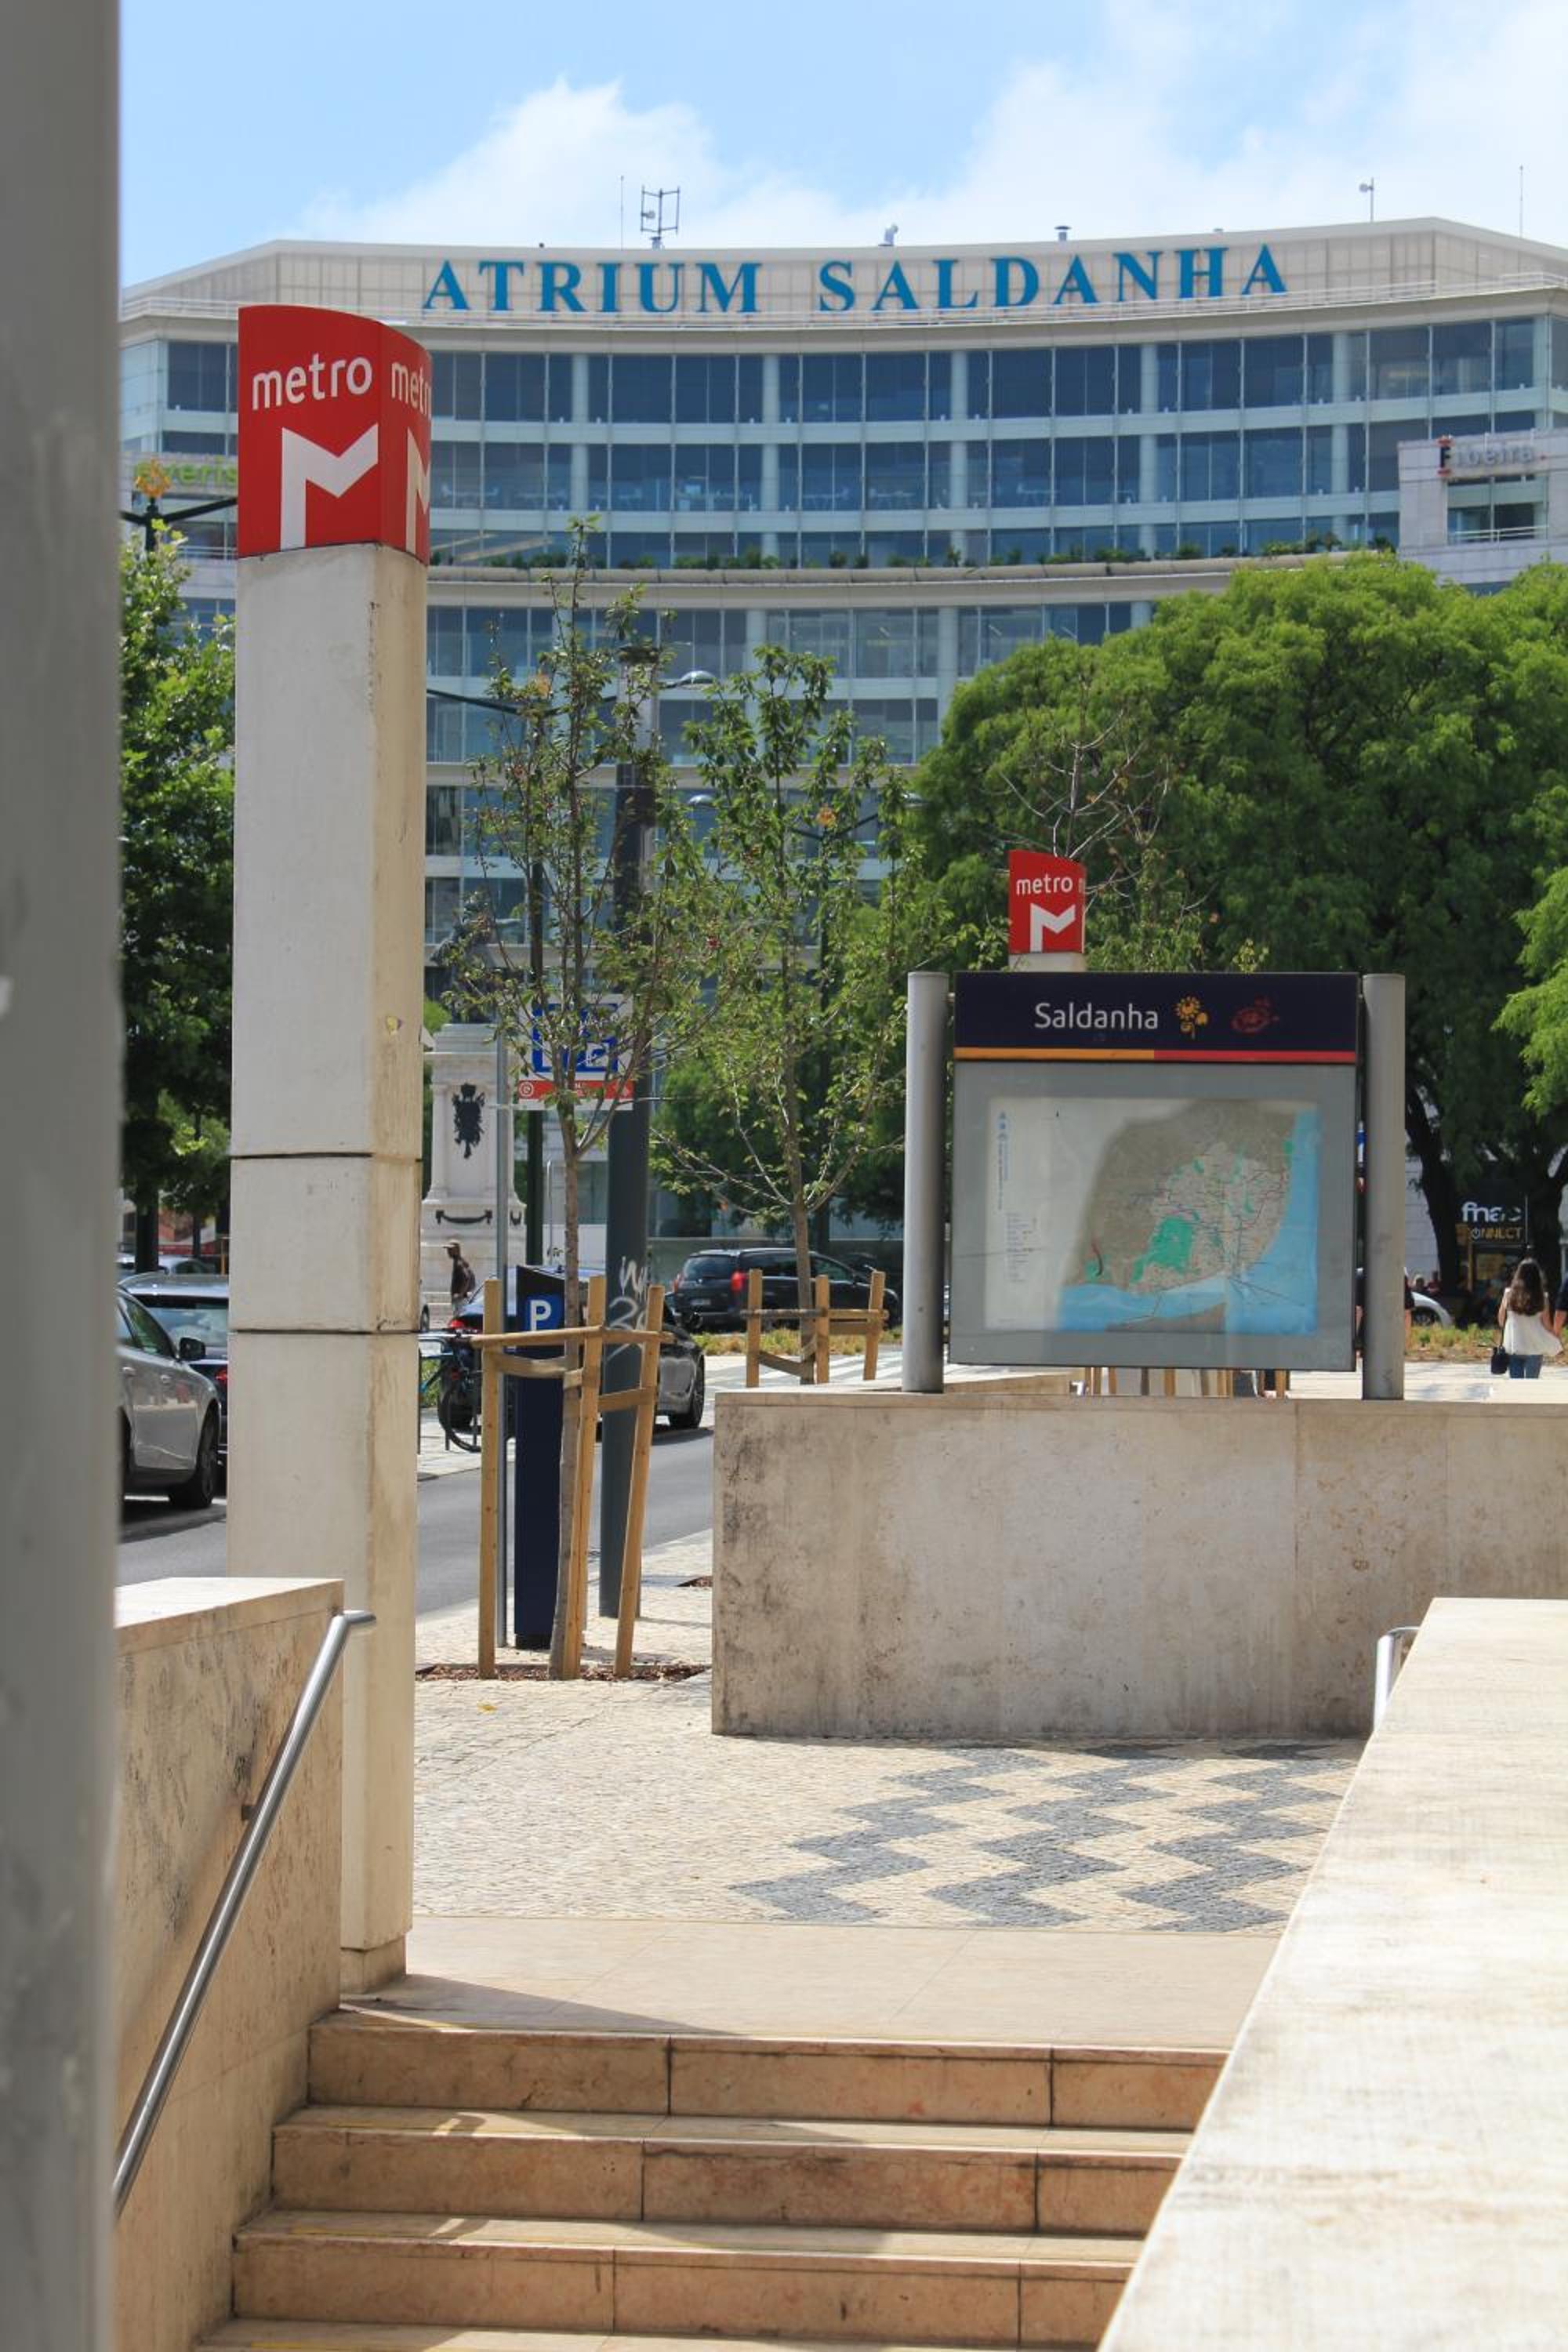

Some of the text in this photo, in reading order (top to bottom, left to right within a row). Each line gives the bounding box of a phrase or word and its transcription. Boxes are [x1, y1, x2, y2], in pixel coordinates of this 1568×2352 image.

[423, 242, 1287, 313] ATRIUM SALDANHA
[252, 354, 372, 411] metro
[391, 361, 431, 420] metr
[1016, 873, 1073, 895] metro
[1034, 1002, 1158, 1029] Saldanha
[530, 1299, 552, 1331] P
